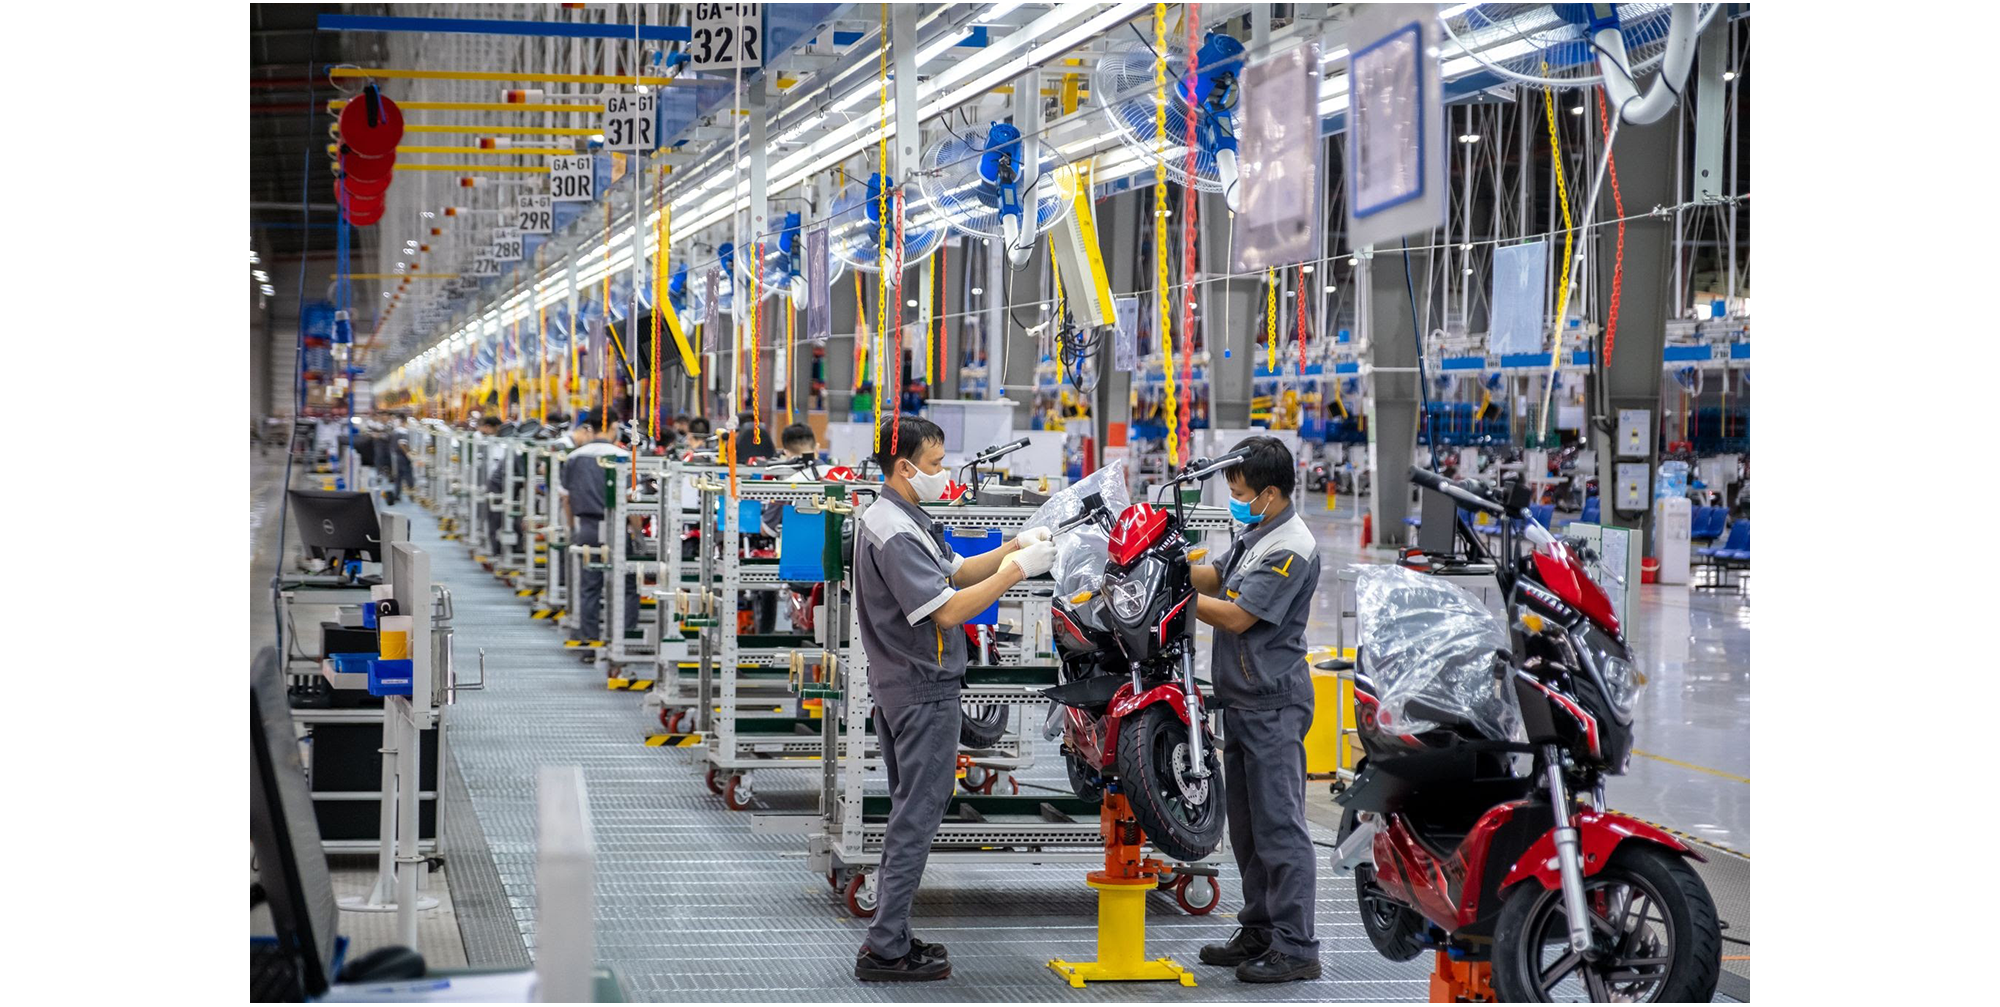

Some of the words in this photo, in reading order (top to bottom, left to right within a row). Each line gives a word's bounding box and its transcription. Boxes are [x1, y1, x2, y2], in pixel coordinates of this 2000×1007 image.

[694, 25, 758, 64] 32R
[608, 95, 653, 113] GA-G1
[608, 117, 650, 145] 31R
[553, 156, 590, 171] GA-G1
[552, 174, 590, 197] 30R
[520, 196, 550, 208] GA-G1
[519, 211, 550, 230] 29R
[495, 241, 520, 258] 28R
[474, 260, 499, 274] 27R
